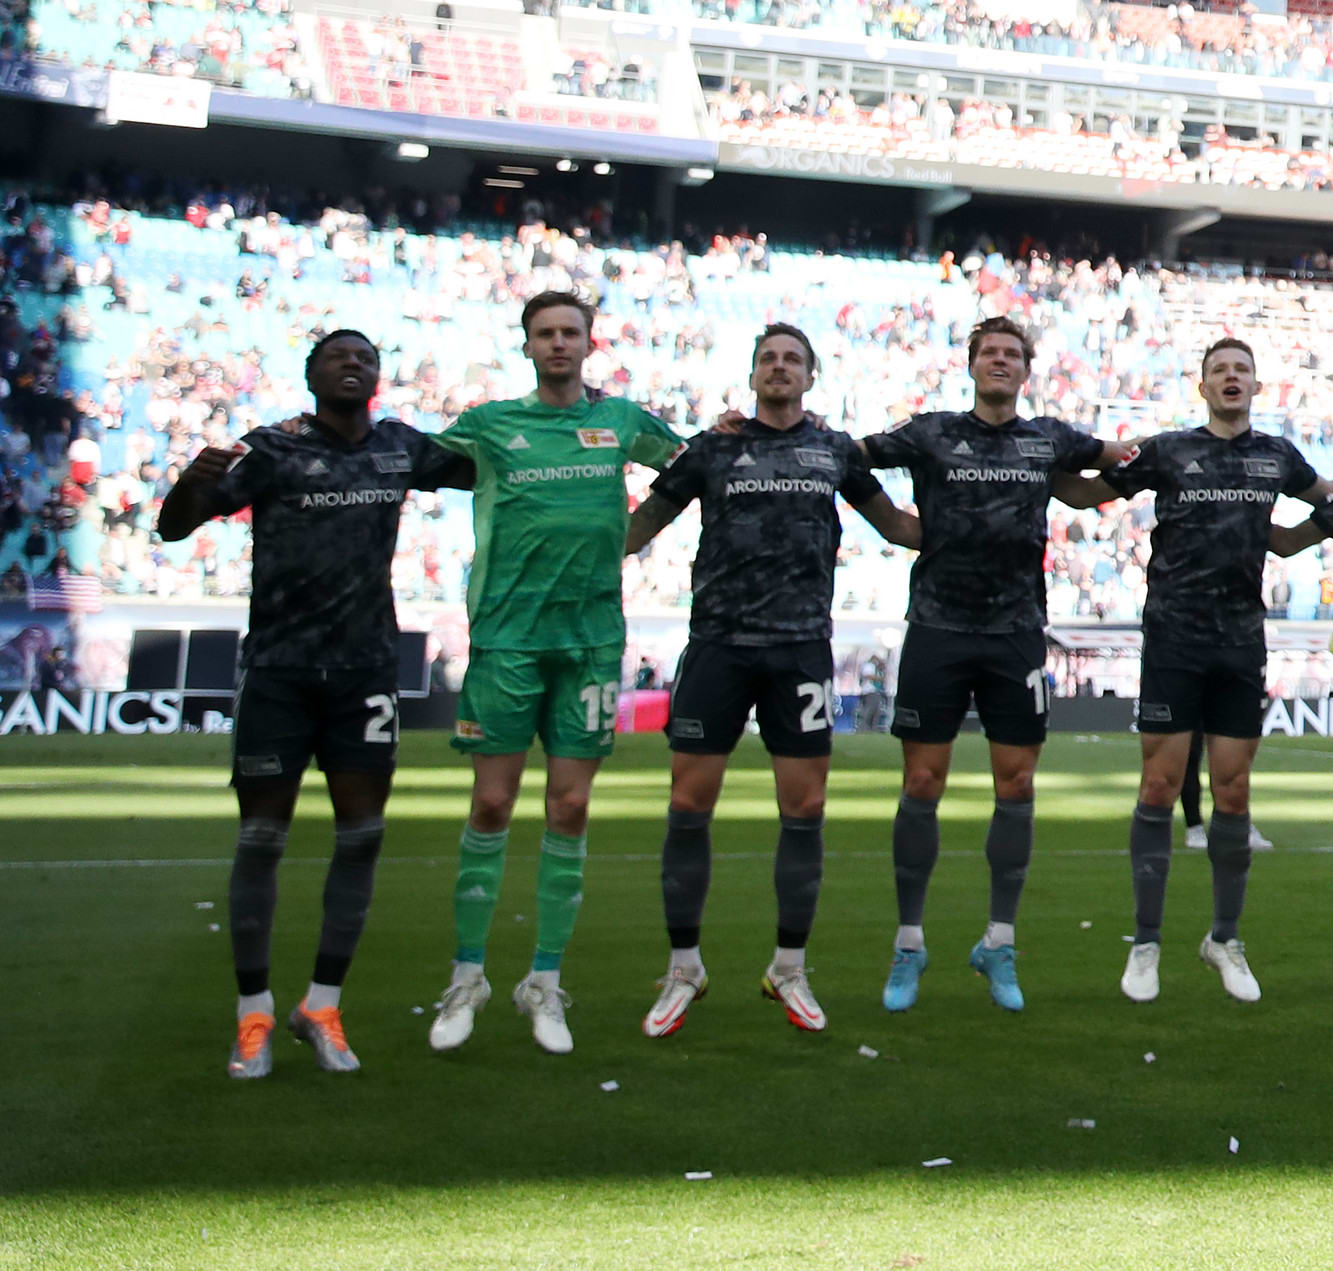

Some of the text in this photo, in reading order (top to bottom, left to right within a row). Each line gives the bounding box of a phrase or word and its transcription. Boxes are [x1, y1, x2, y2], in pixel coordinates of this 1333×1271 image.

[508, 463, 617, 484] AROUNDTOWN
[944, 467, 1049, 484] AROUNDTOWN
[725, 477, 835, 496] AROUNDTOWN
[1178, 488, 1275, 505] AROUNDTOWN
